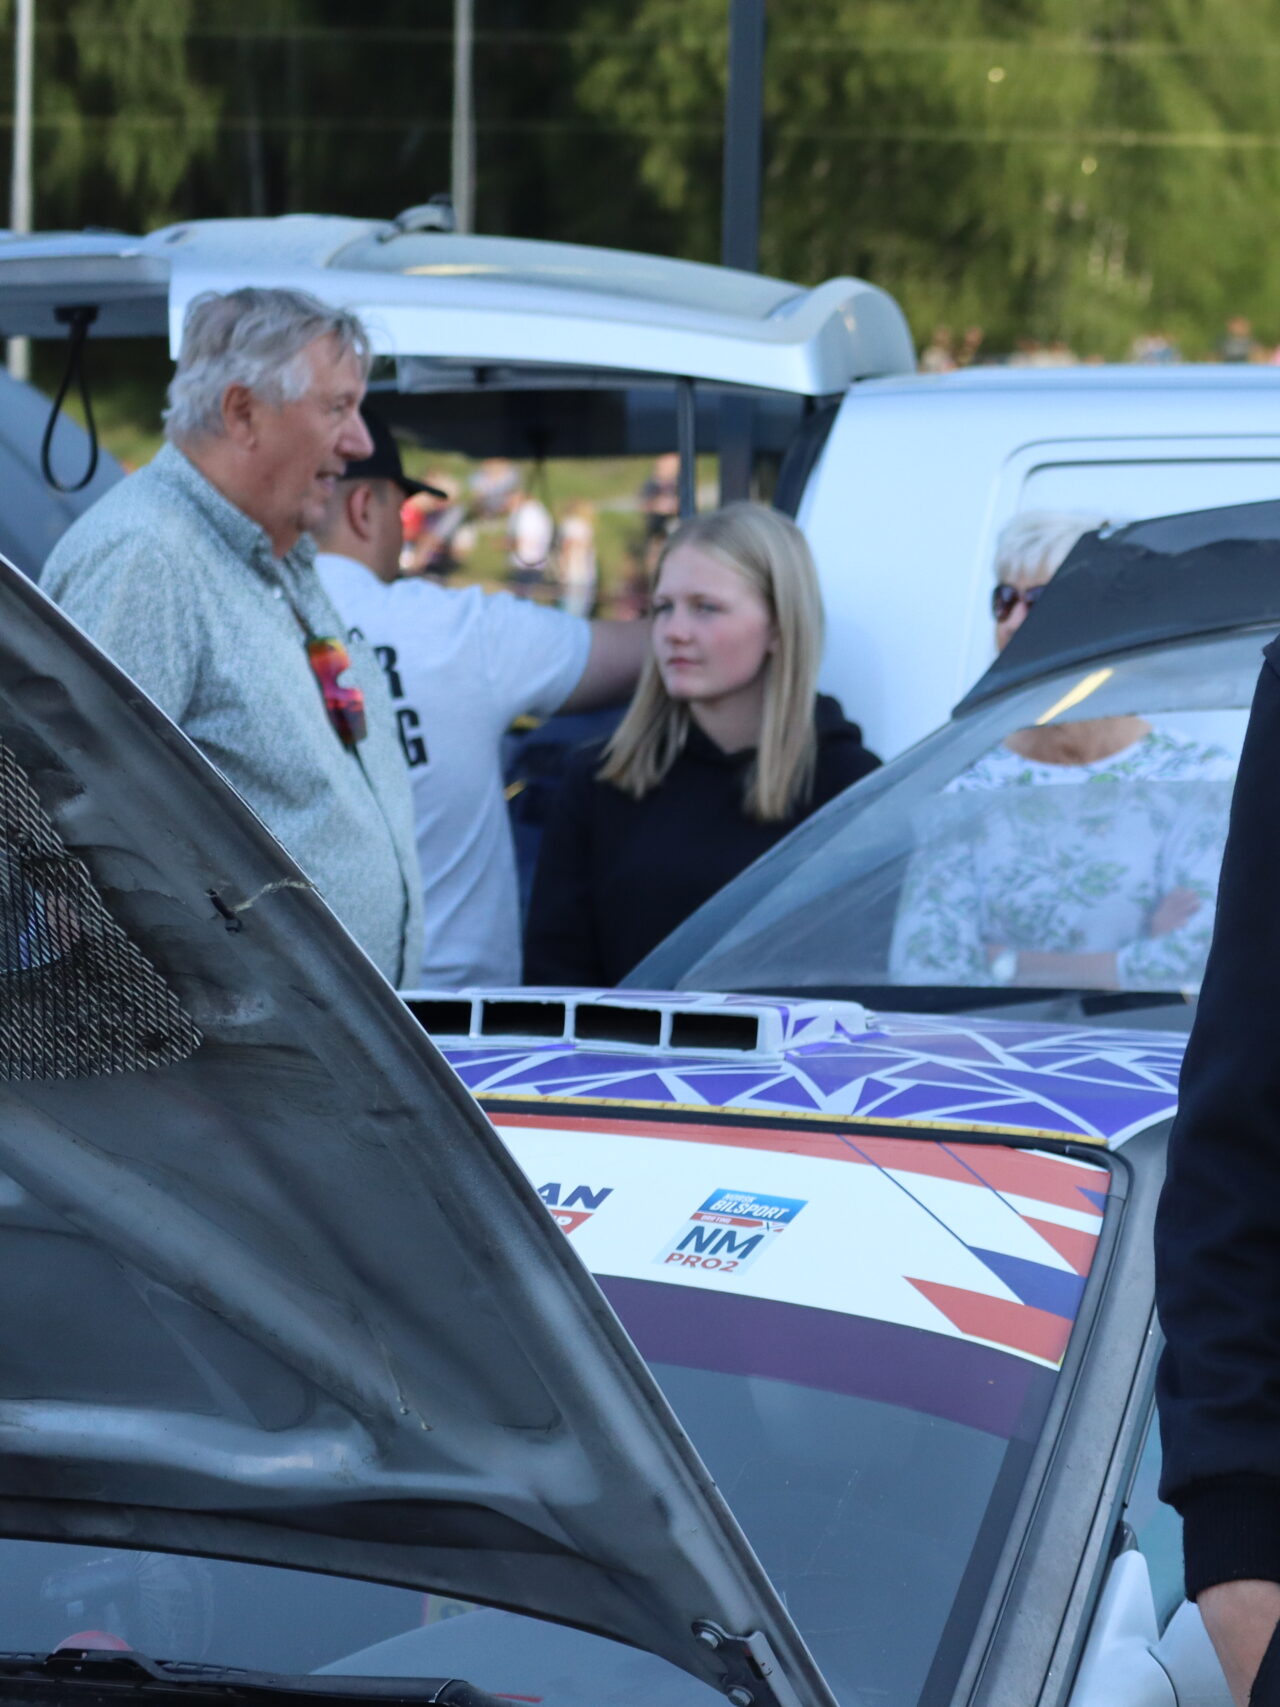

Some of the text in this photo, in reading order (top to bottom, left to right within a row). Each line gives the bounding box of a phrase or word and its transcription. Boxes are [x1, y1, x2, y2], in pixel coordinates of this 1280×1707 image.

[709, 1200, 790, 1220] BILSPORT
[675, 1225, 765, 1260] NM
[663, 1252, 739, 1272] PRO2
